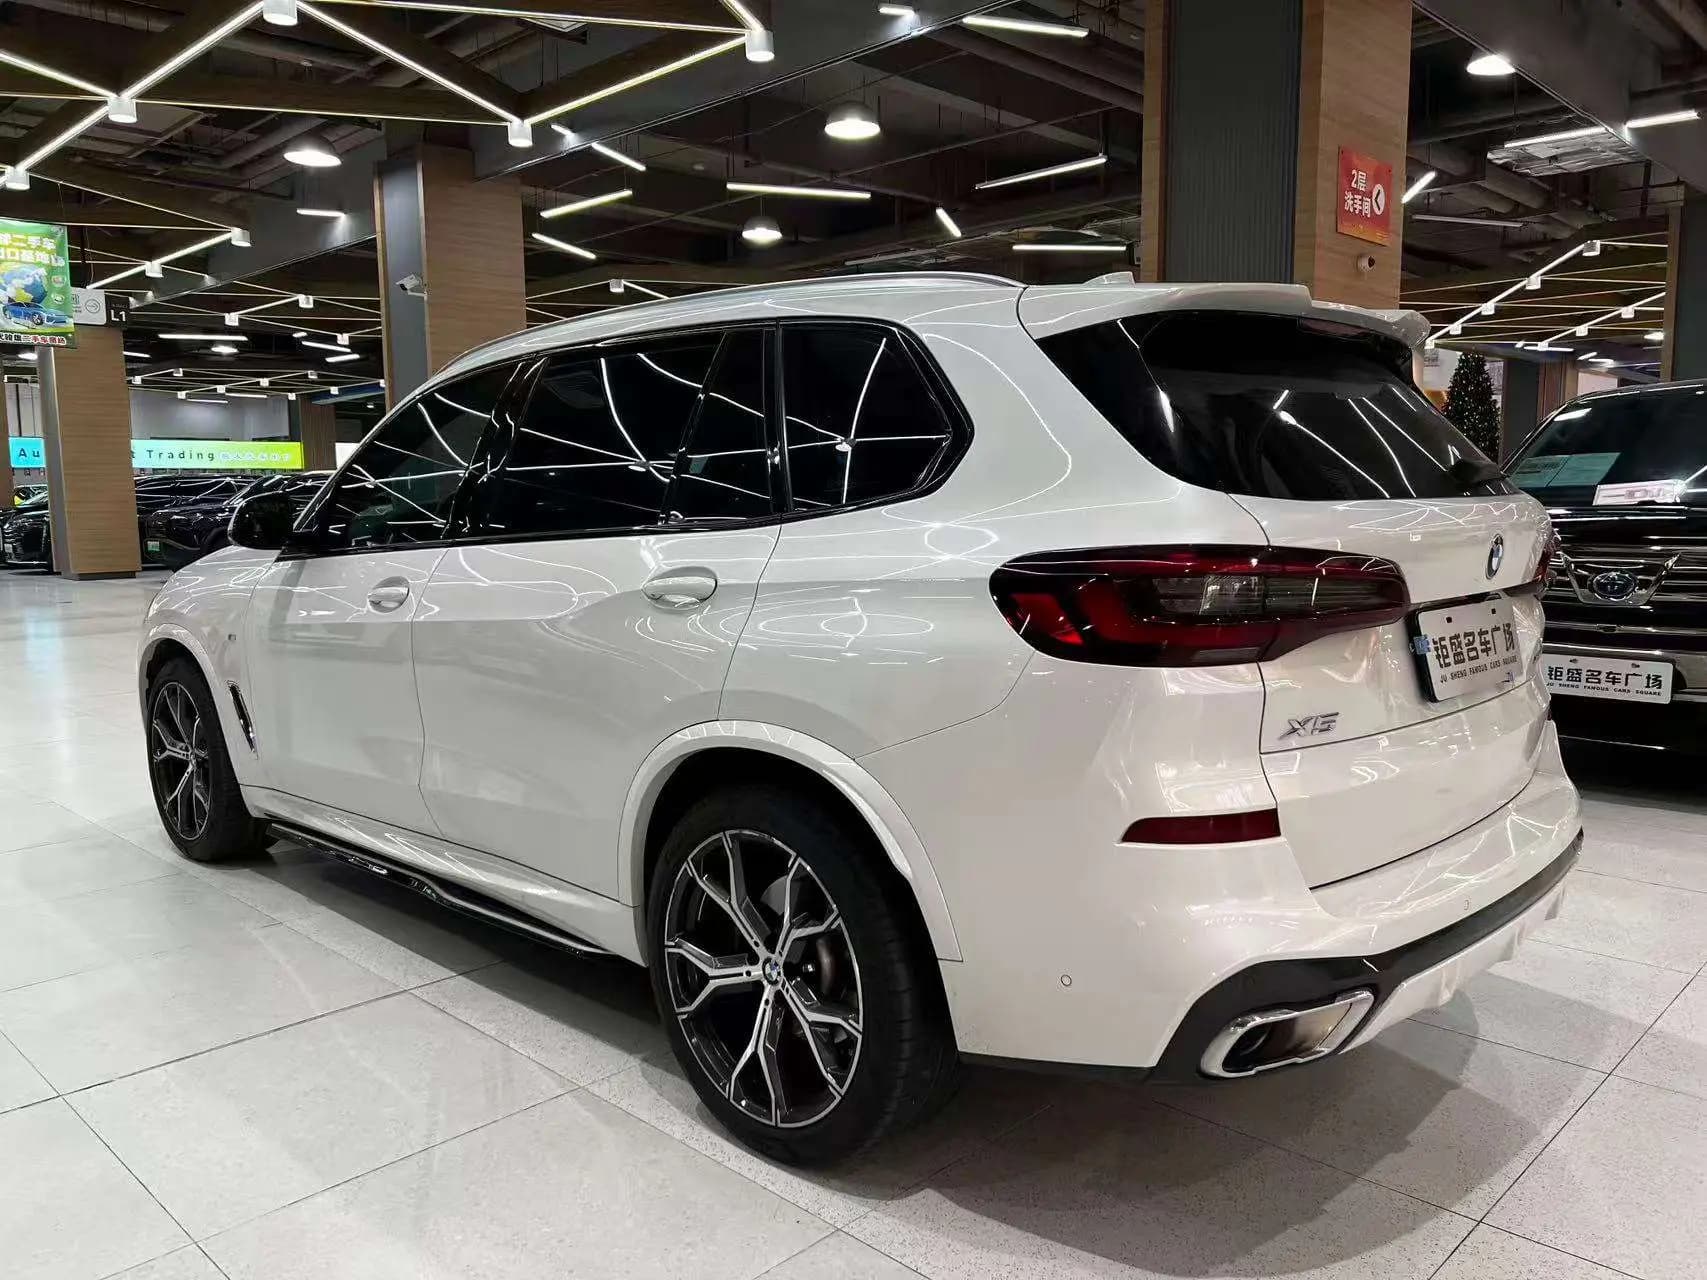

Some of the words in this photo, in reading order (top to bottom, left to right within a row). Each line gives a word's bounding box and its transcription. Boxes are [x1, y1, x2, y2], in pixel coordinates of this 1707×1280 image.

[1351, 169, 1367, 191] 2层
[1344, 190, 1371, 218] 洗手间
[111, 309, 126, 322] L1
[147, 449, 215, 462] Trading
[1432, 622, 1515, 669] 钜盛名车广场
[1440, 674, 1448, 684] JU
[1450, 669, 1467, 680] SHENG
[1469, 663, 1488, 675] FAMOUS
[1490, 660, 1501, 671] CARS
[1547, 665, 1663, 690] 钜盛名车广场
[1635, 689, 1662, 697] SQUARE
[1279, 711, 1339, 738] X5
